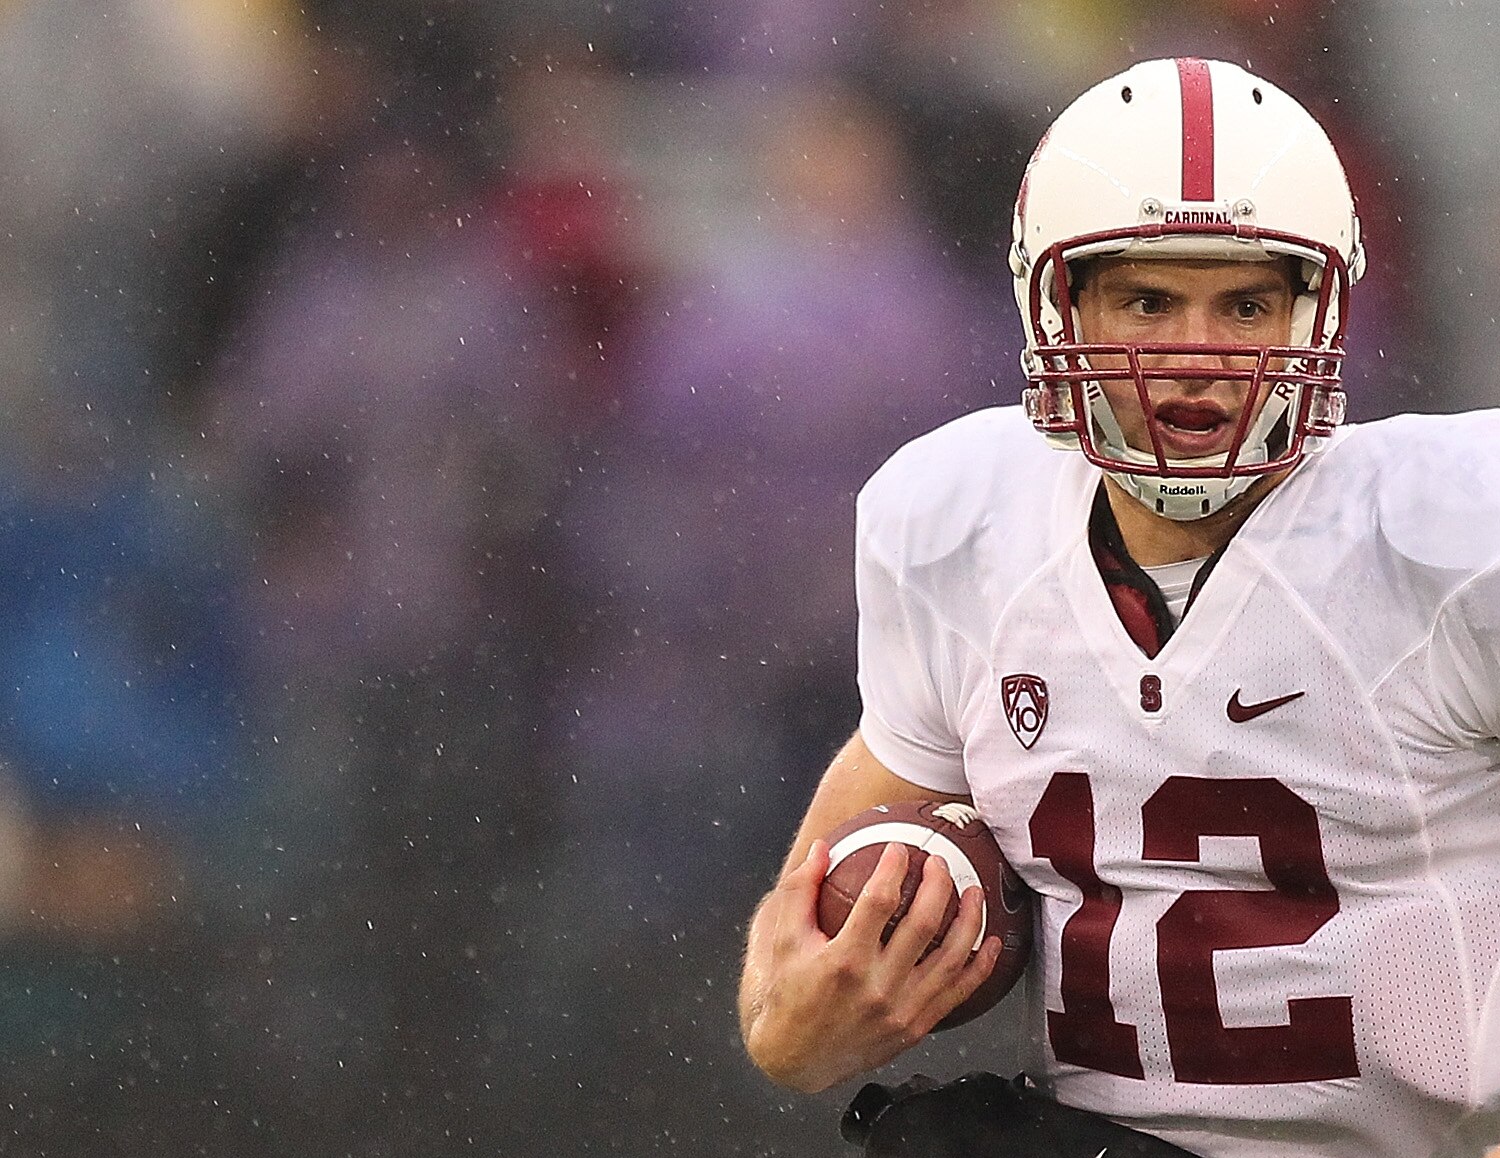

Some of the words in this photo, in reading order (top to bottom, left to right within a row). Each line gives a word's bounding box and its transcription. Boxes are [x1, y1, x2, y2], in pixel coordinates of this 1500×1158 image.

[1165, 211, 1231, 225] CARDINAL
[1015, 706, 1040, 733] 10
[1028, 772, 1361, 1084] 12
